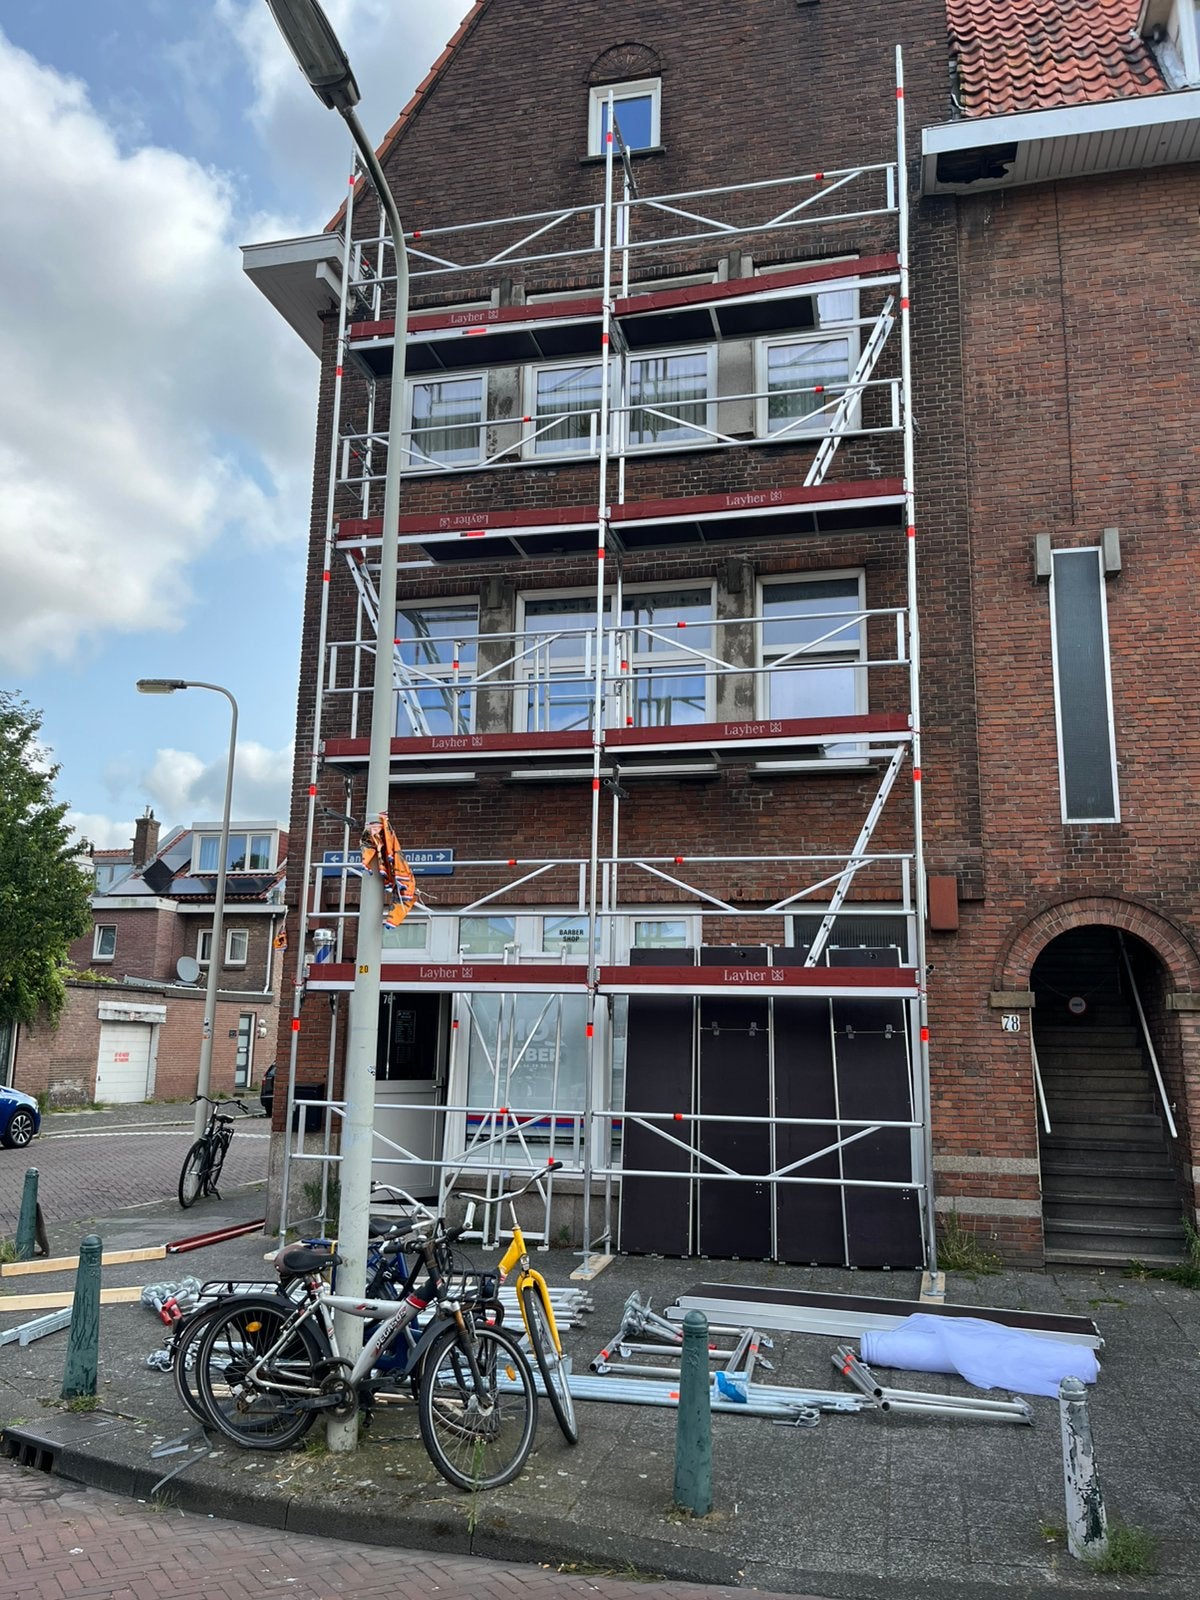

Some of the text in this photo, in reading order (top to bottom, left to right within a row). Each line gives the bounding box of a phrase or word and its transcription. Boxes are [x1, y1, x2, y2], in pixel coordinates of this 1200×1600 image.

[450, 312, 485, 324] Layher
[726, 494, 766, 506] Layher
[453, 513, 489, 525] Layher
[724, 724, 766, 736] Layher
[431, 737, 468, 749] Layher
[420, 967, 458, 980] Layher
[724, 969, 766, 983] Layher
[1003, 1016, 1019, 1030] 78
